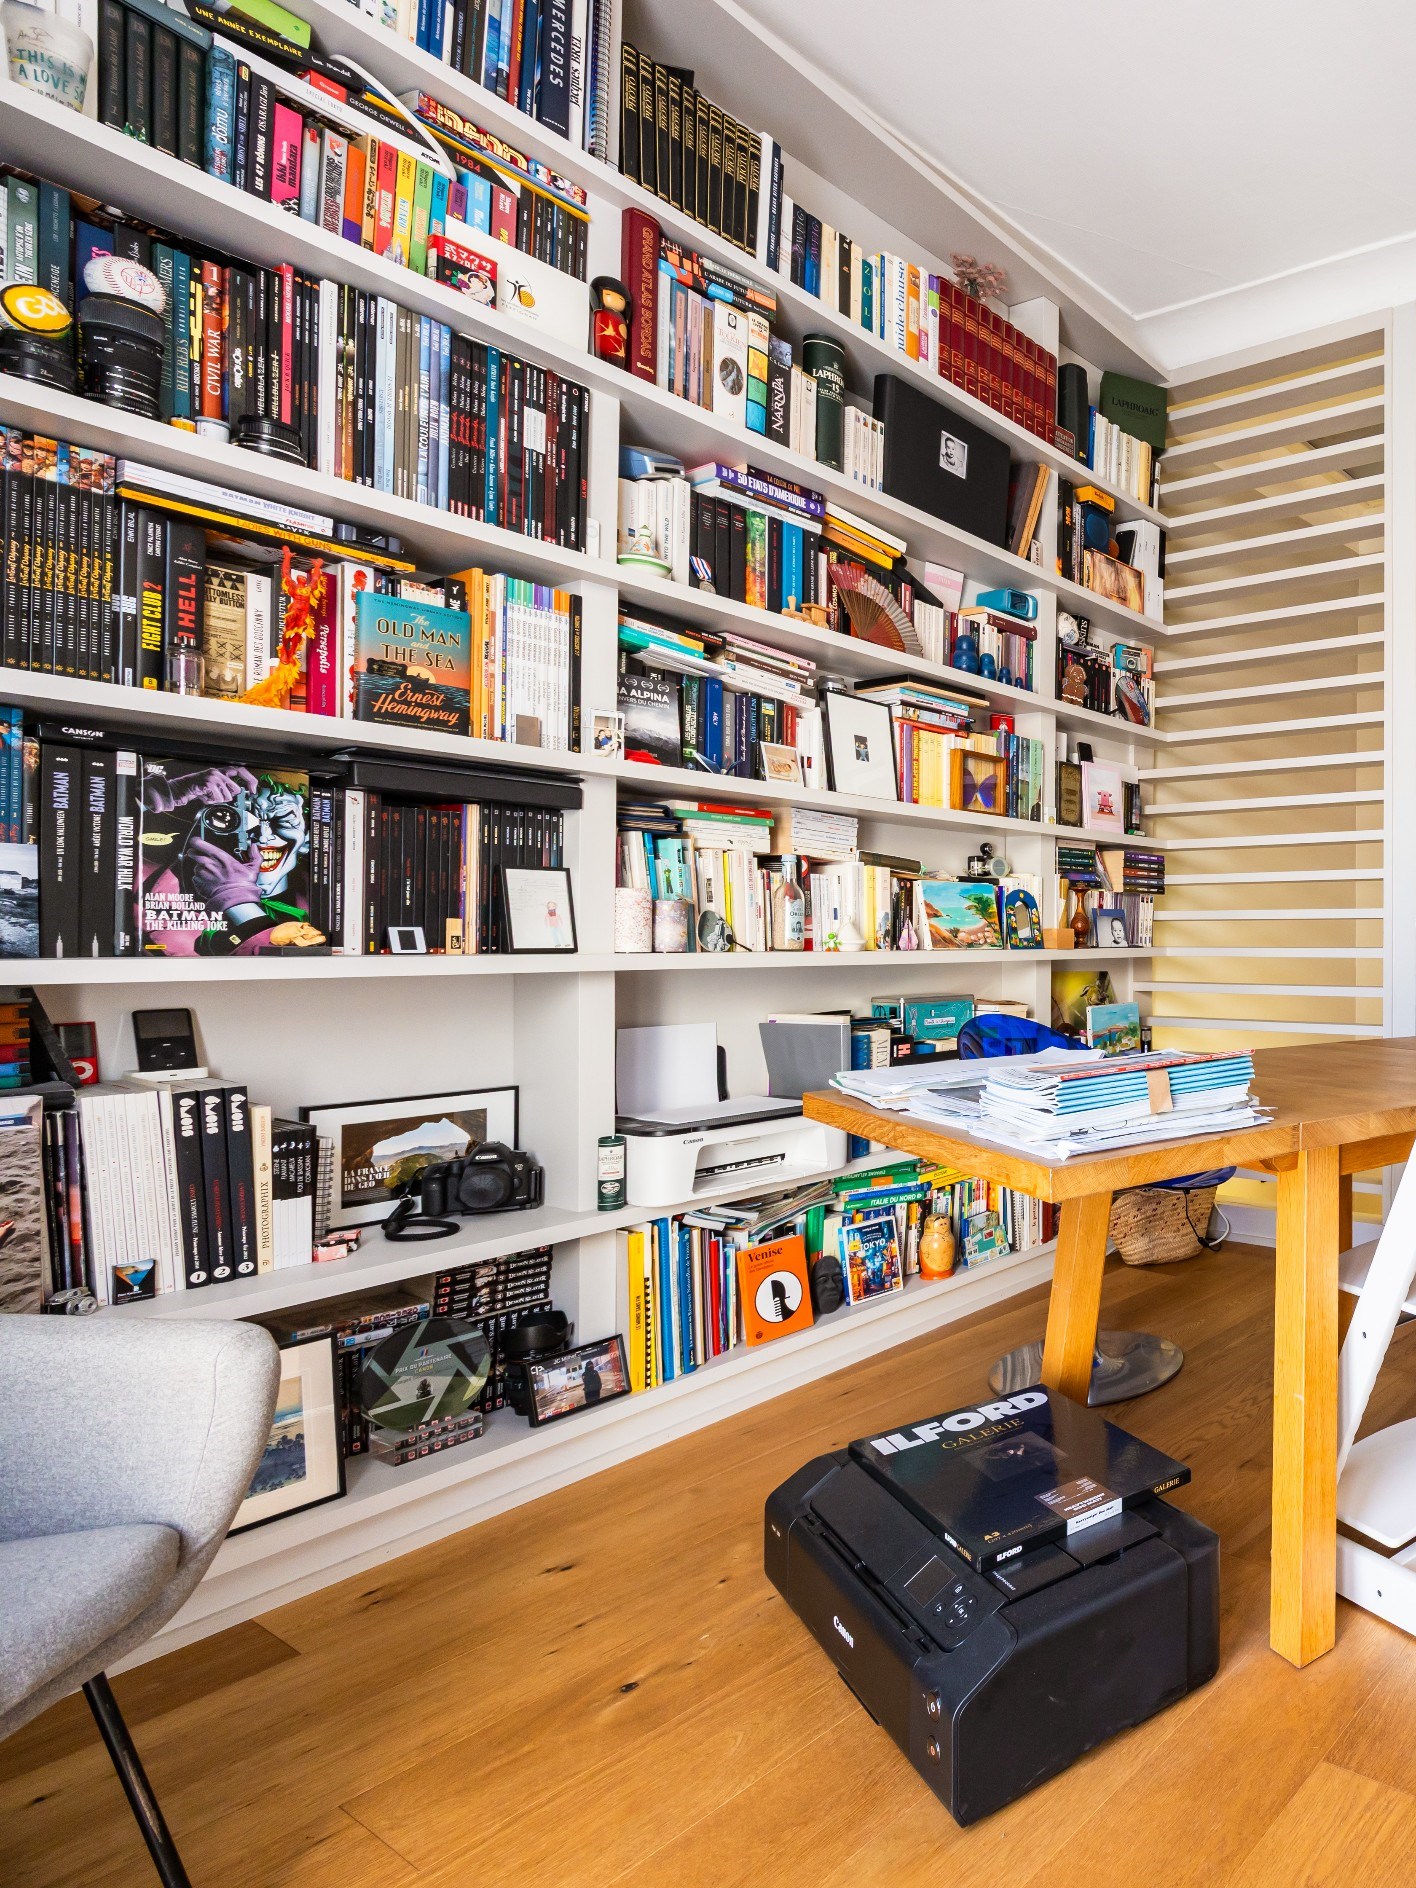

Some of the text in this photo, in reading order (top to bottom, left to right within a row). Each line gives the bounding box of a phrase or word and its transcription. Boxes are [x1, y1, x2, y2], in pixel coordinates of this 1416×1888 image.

[195, 7, 215, 21] UNE
[217, 16, 247, 34] ANNÉE
[249, 29, 303, 57] EXEMPLAIRE
[16, 49, 54, 70] THIS
[569, 36, 582, 106] Jacques BREL
[19, 63, 28, 80] A
[34, 69, 69, 95] LOVE
[349, 97, 407, 132] GEORGE ORWELL
[456, 152, 481, 173] 1984
[210, 268, 219, 282] 1
[897, 261, 905, 311] clause
[641, 227, 654, 359] GRAND ATLAS BORDAS
[207, 328, 221, 395] CIVIL WAR
[177, 367, 188, 394] RIFF
[772, 377, 786, 434] NARNIA
[1112, 397, 1160, 417] LAPHROAIG
[420, 408, 429, 450] COULEUR
[440, 405, 450, 447] ANIMAL'Z
[737, 473, 807, 509] 50 ETATS D'AMERIQUE
[128, 512, 136, 527] BILAL
[263, 500, 287, 514] WHITE
[288, 509, 315, 521] KNIGHT
[236, 519, 332, 551] LADIES WITH GUNS
[143, 590, 162, 618] CLUB
[178, 572, 197, 627] HELL
[219, 598, 245, 609] BUTTON
[411, 613, 431, 626] The
[141, 619, 162, 651] FIGHT
[376, 617, 461, 648] OLD MAN
[316, 625, 331, 674] Persepolis
[382, 643, 457, 672] THE SEA
[411, 641, 429, 650] and
[395, 682, 447, 706] Ernest
[629, 689, 670, 704] ALPINA
[647, 700, 670, 710] CHEMIN
[372, 693, 461, 726] Hemingway
[61, 726, 104, 738] CANSON
[53, 771, 69, 809] BATMAN
[90, 776, 106, 813] BATMAN
[322, 799, 331, 823] BATMAN
[117, 816, 133, 890] WORLD WAR HULK
[145, 892, 194, 902] ALAN MOORE
[145, 901, 206, 911] BRIAN BOLLAND
[145, 910, 224, 921] BATMAN
[145, 920, 228, 931] THE KILLING JOKE
[683, 1136, 704, 1145] Canon
[345, 1164, 390, 1179] LA FRANCE
[345, 1175, 367, 1186] DANS
[345, 1179, 376, 1191] DE GEO
[870, 1197, 889, 1207] ITALIE
[899, 1193, 916, 1203] NORD
[261, 1181, 269, 1250] PHOTOGRAPHIX
[748, 1246, 784, 1262] Venise
[860, 1238, 886, 1251] TOKYO
[419, 1353, 452, 1368] PARTENAIRE
[869, 1391, 1049, 1456] ILFORD
[941, 1418, 1025, 1450] GALERIE
[1154, 1477, 1180, 1495] GALERIE
[984, 1531, 1000, 1542] A3
[996, 1545, 1023, 1562] ILFORD
[833, 1616, 855, 1649] Canon
